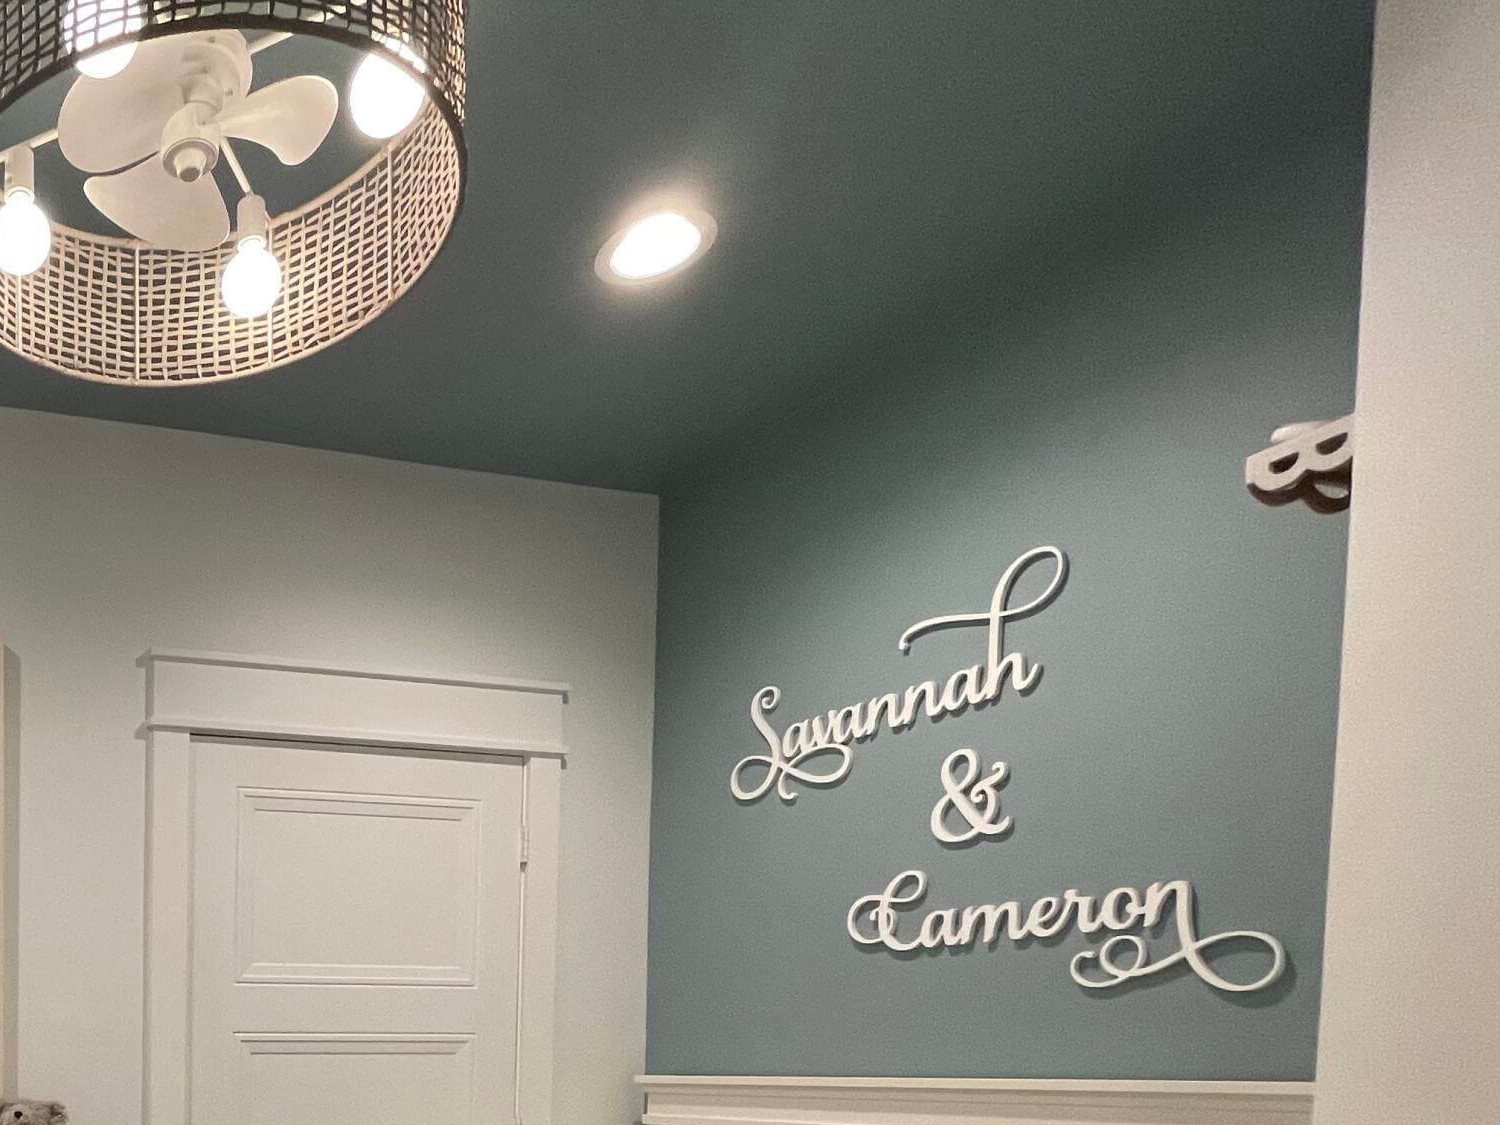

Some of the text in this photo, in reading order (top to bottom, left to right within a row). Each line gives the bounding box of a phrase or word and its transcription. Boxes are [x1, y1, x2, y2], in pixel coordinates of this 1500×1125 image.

[730, 545, 1067, 801] Savannah
[929, 747, 1012, 843] &
[847, 869, 1287, 992] Cameron
